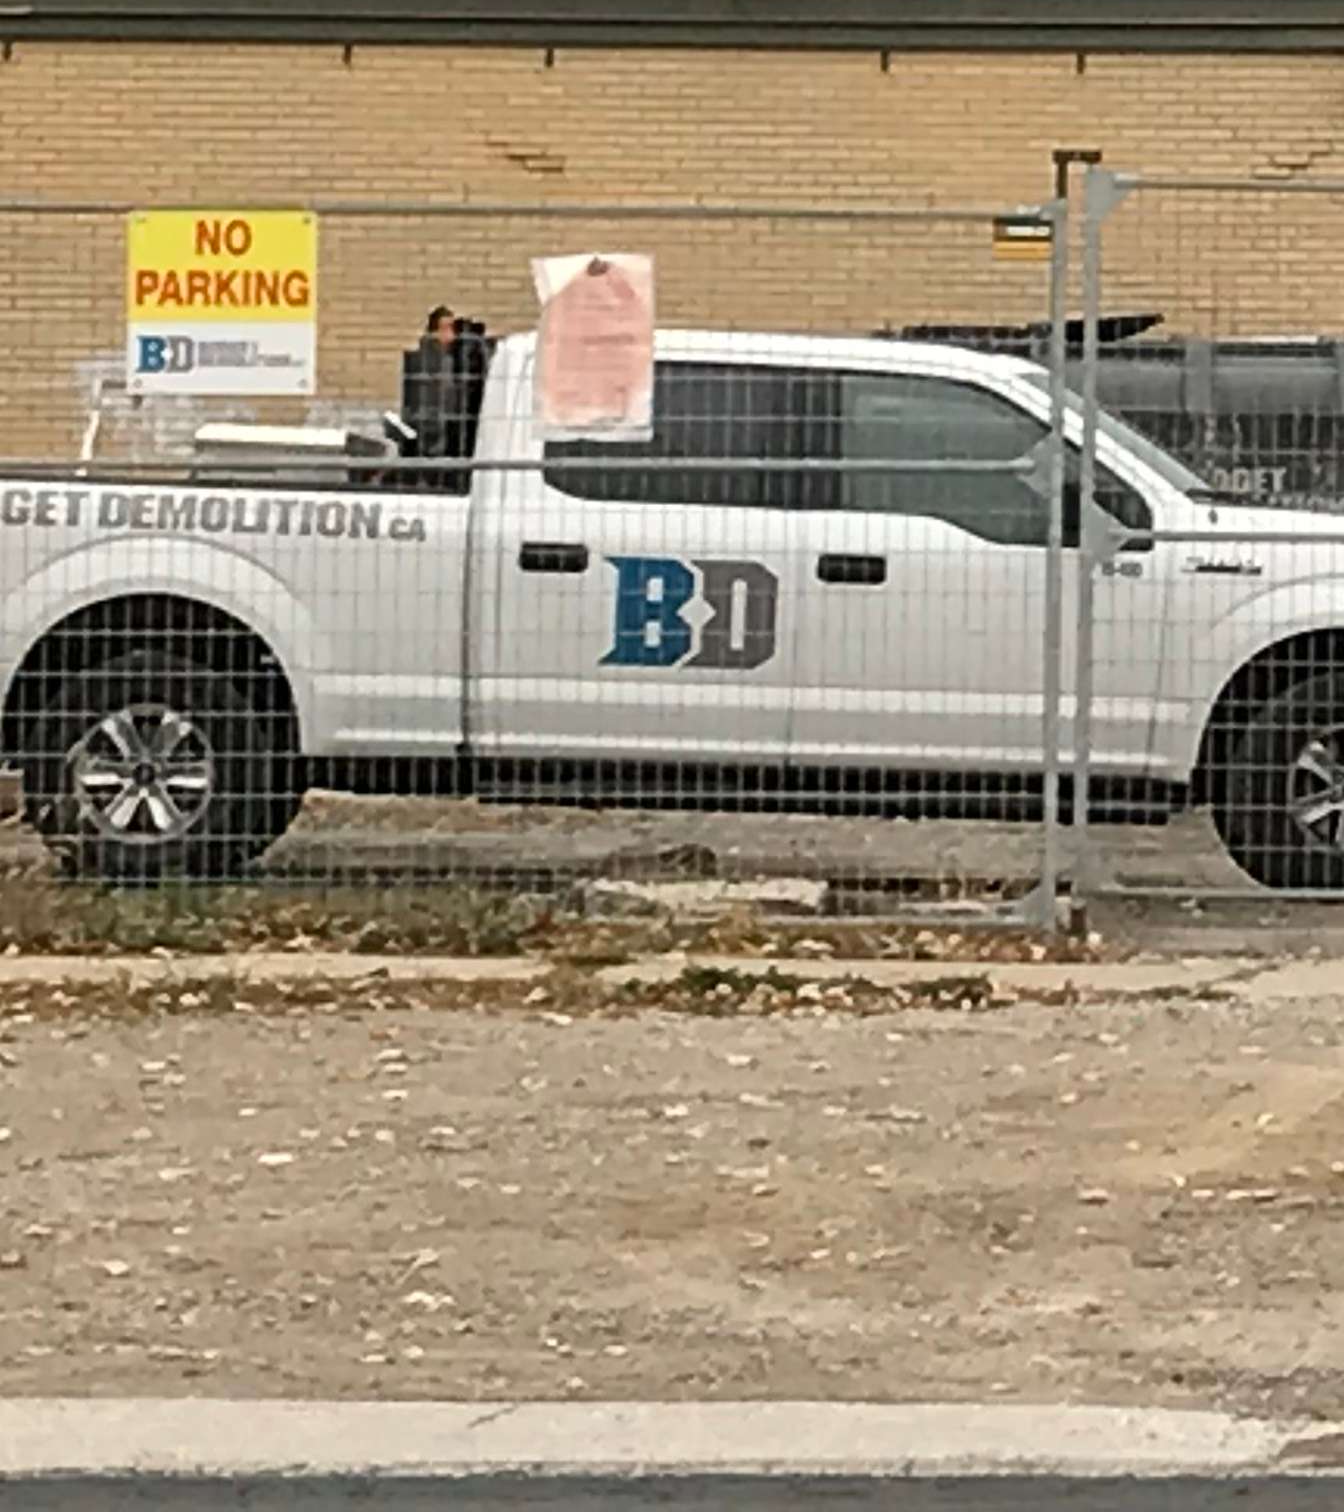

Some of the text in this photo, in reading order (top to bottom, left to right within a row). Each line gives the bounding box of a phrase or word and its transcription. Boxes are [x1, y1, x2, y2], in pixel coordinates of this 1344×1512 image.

[194, 219, 252, 256] NO
[135, 269, 310, 307] PARKING
[135, 335, 194, 373] BD
[0, 491, 91, 527] GET
[598, 557, 780, 670] BD
